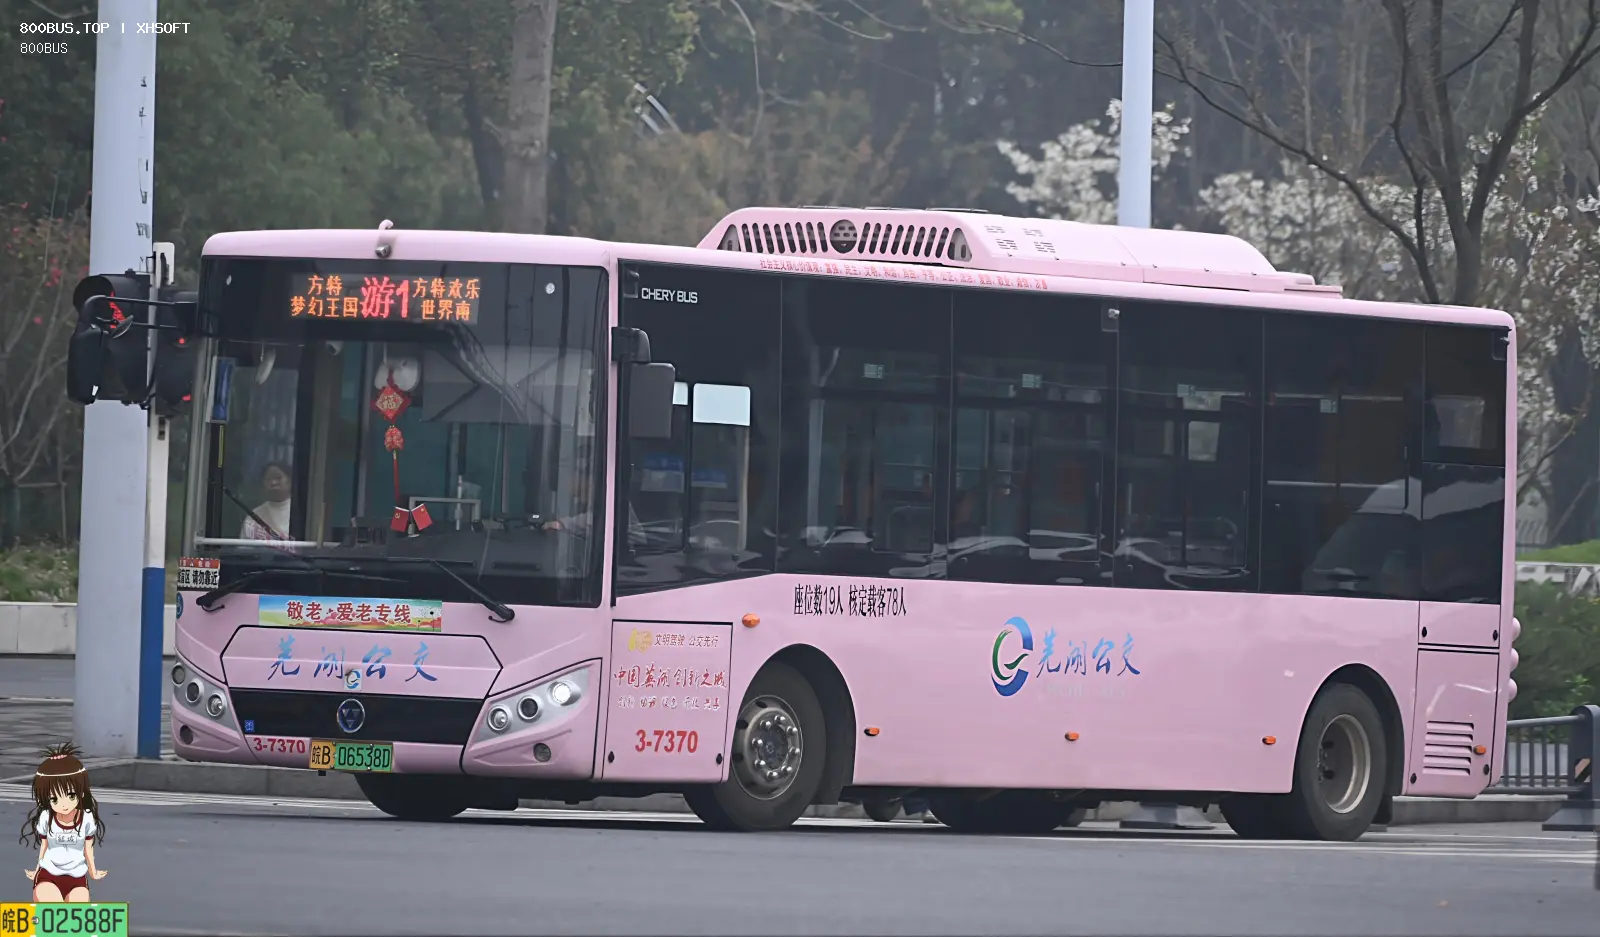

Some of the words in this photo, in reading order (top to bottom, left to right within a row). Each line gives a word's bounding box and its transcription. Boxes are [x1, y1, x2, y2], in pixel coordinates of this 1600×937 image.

[307, 274, 343, 296] 方特
[412, 277, 481, 299] 方特欢乐
[641, 287, 676, 302] CHERY
[676, 290, 698, 304] BUS
[290, 296, 358, 318] 梦幻王国
[360, 276, 409, 319] 游1
[420, 299, 471, 321] 世界南
[793, 583, 844, 616] 座位数19人
[848, 584, 907, 617] 核定载客78人
[688, 635, 720, 648] 公交先行
[253, 737, 306, 754] 3-7370
[634, 729, 699, 754] 3-7370
